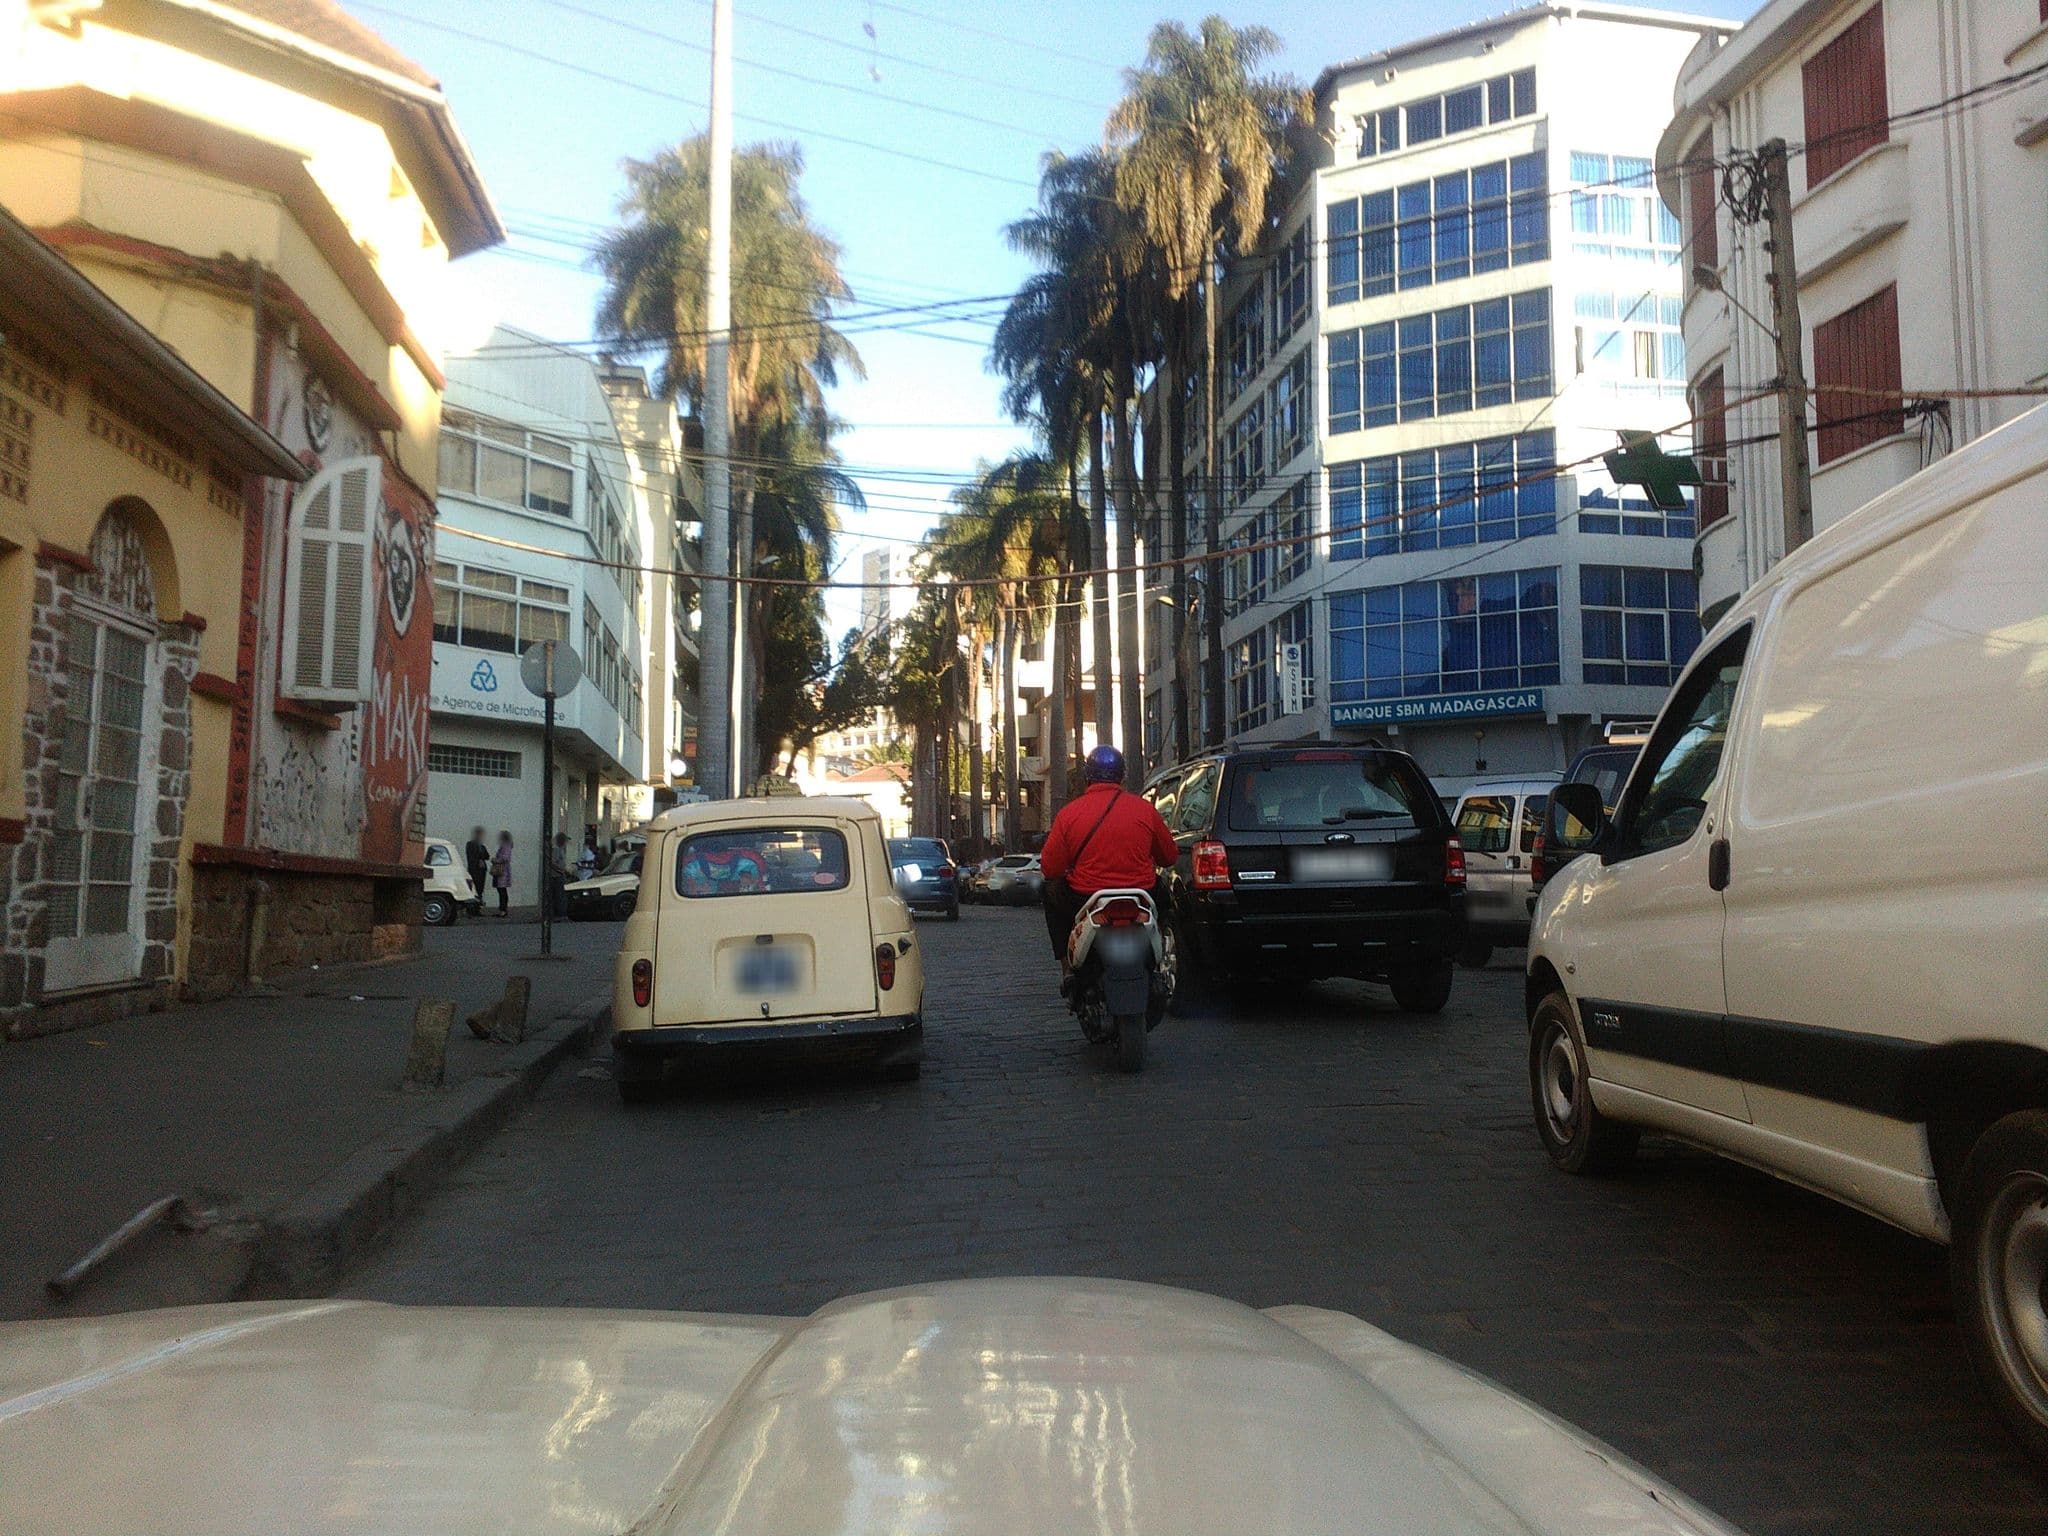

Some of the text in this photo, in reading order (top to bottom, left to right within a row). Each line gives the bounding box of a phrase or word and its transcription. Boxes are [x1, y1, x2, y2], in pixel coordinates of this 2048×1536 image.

[443, 695, 483, 711] Agence
[486, 701, 500, 713] de
[1334, 694, 1538, 721] BANQUE SBM MADAGASCAR
